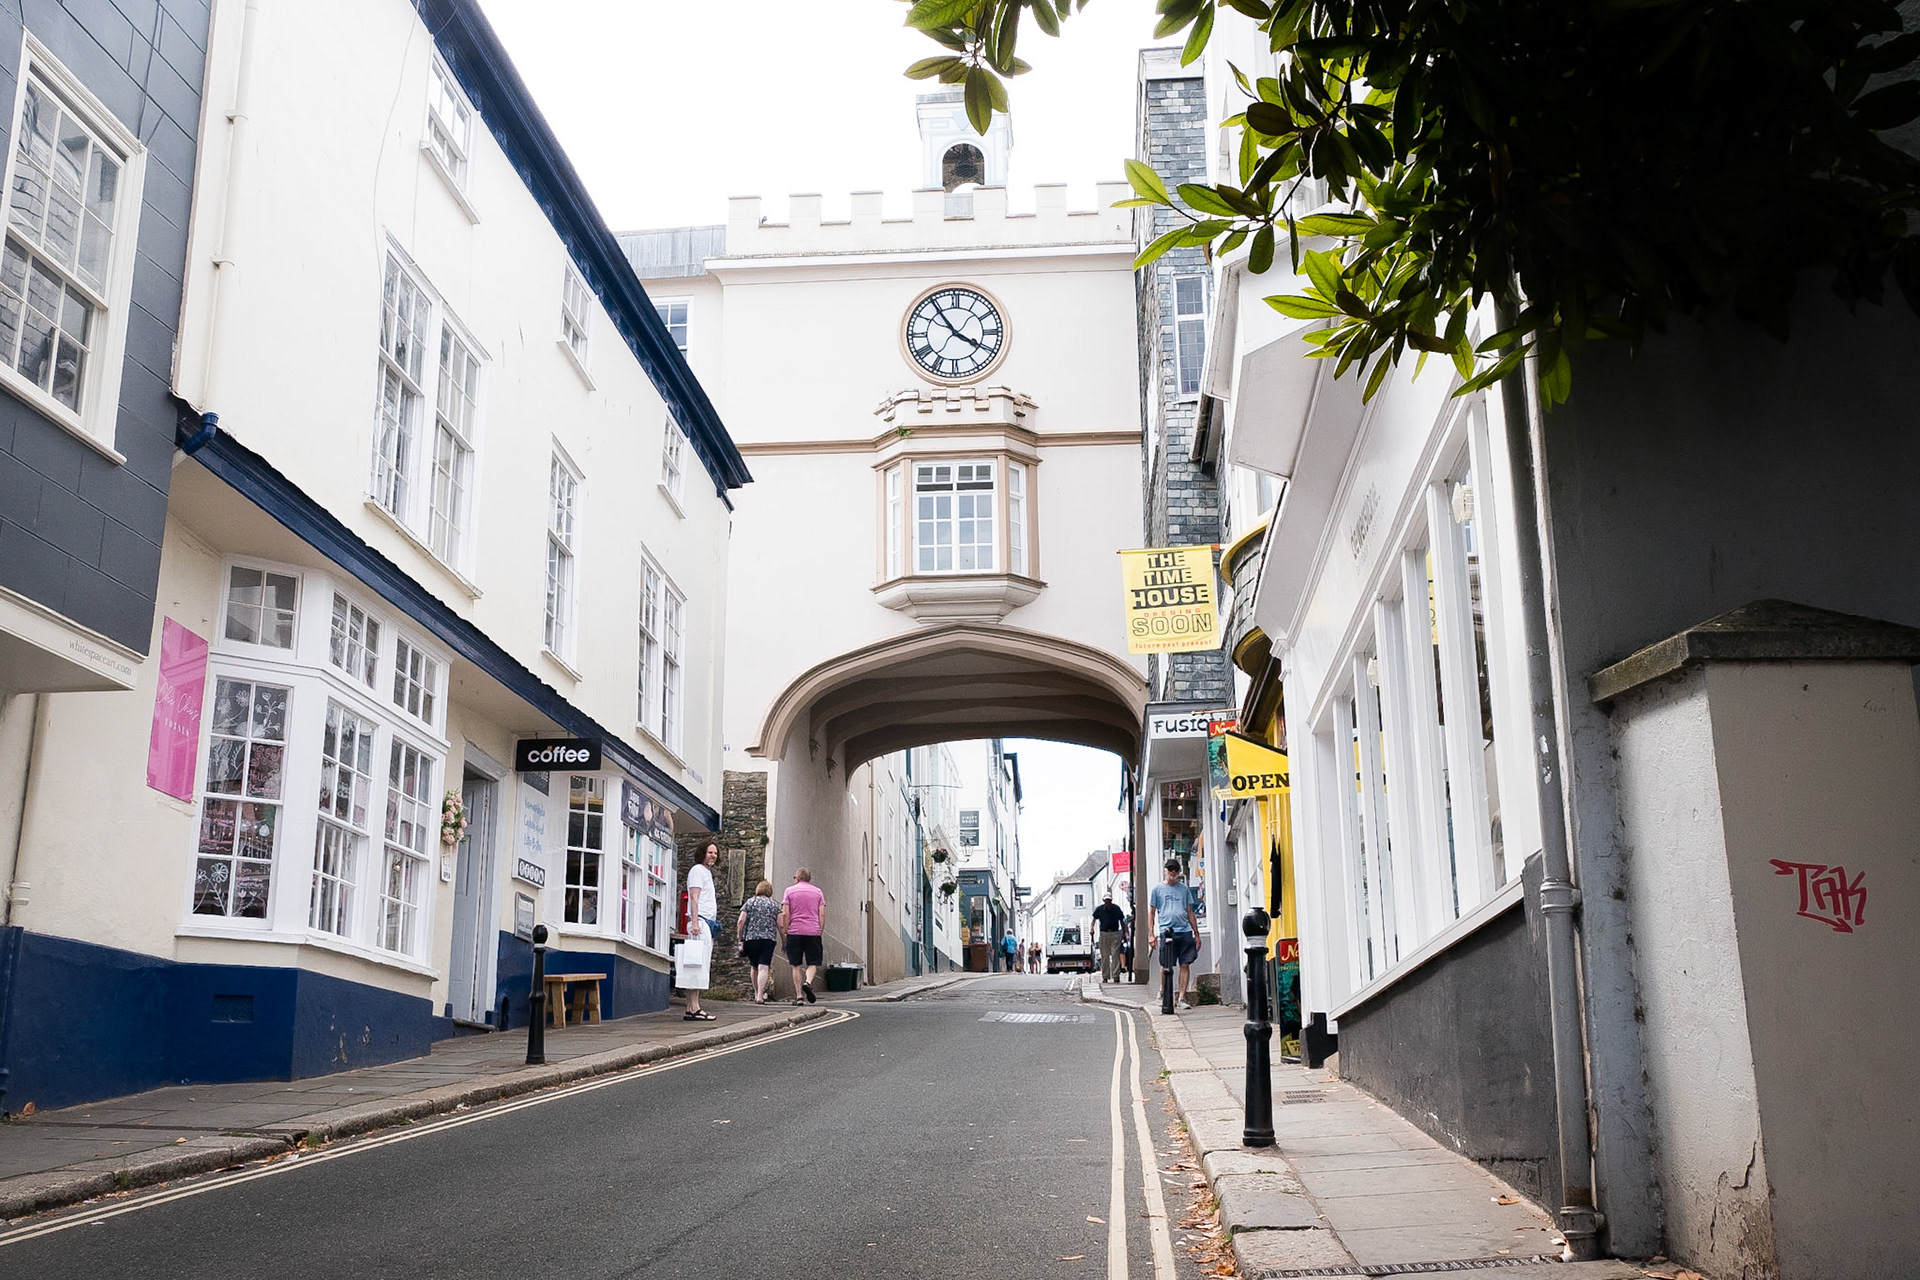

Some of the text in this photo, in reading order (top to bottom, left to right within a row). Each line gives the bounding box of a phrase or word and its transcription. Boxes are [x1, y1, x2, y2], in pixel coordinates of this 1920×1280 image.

[1147, 551, 1185, 569] THE
[1143, 567, 1192, 586] TIME
[1131, 584, 1209, 609] HOUSE
[1143, 608, 1201, 618] OPENING
[1132, 613, 1212, 636] SOON
[1153, 717, 1222, 734] FUSIO
[528, 745, 590, 763] coffee
[1232, 772, 1290, 791] OPEN
